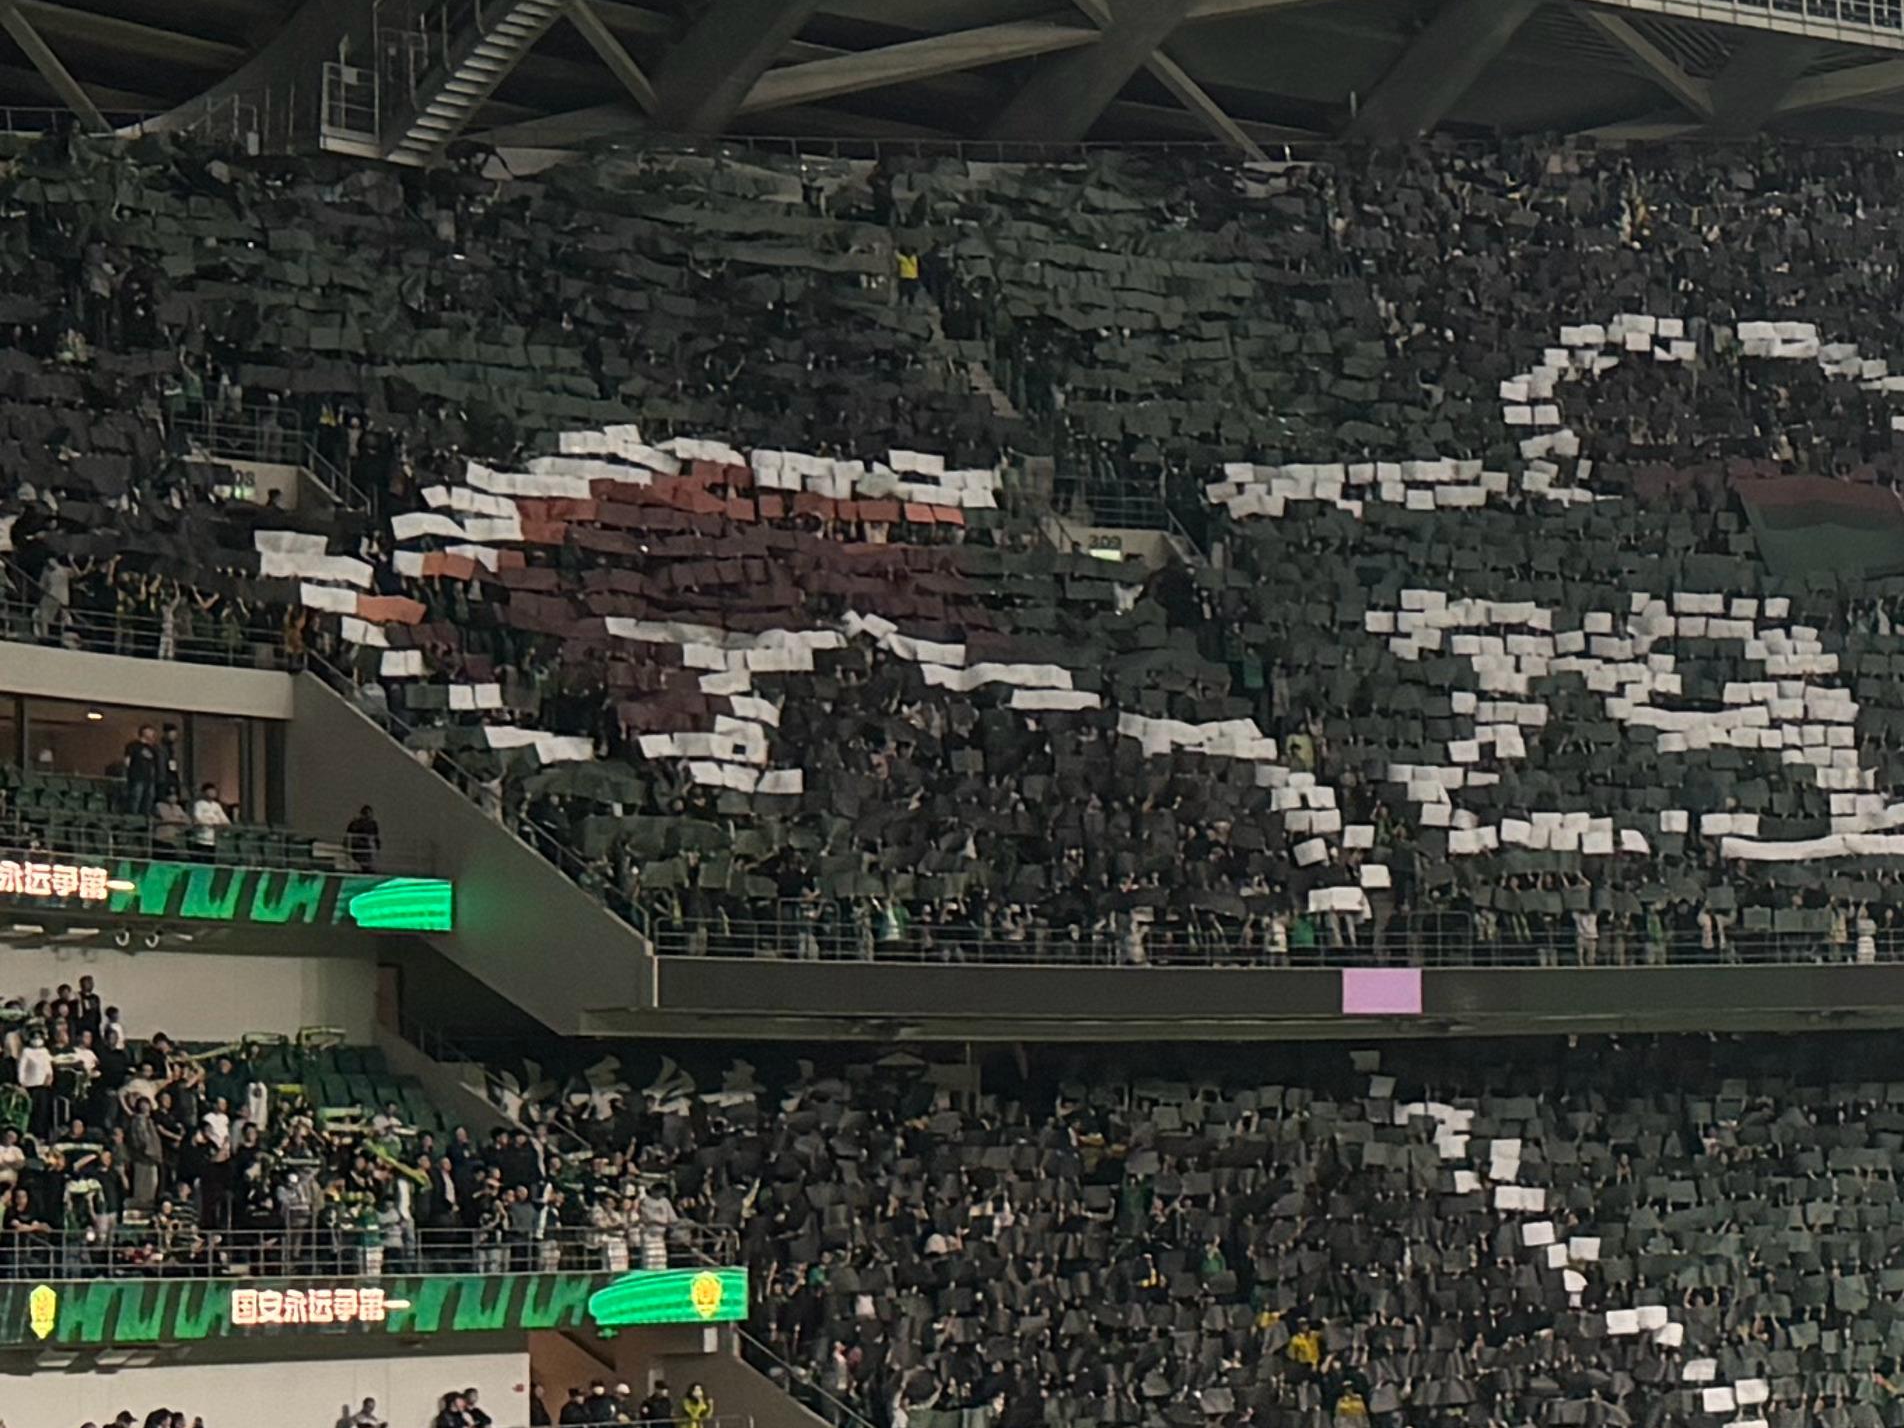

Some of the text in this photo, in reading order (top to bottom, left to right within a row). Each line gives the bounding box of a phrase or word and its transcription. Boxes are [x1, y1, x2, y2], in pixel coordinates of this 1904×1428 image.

[231, 1287, 411, 1325] 国安永远争第一
